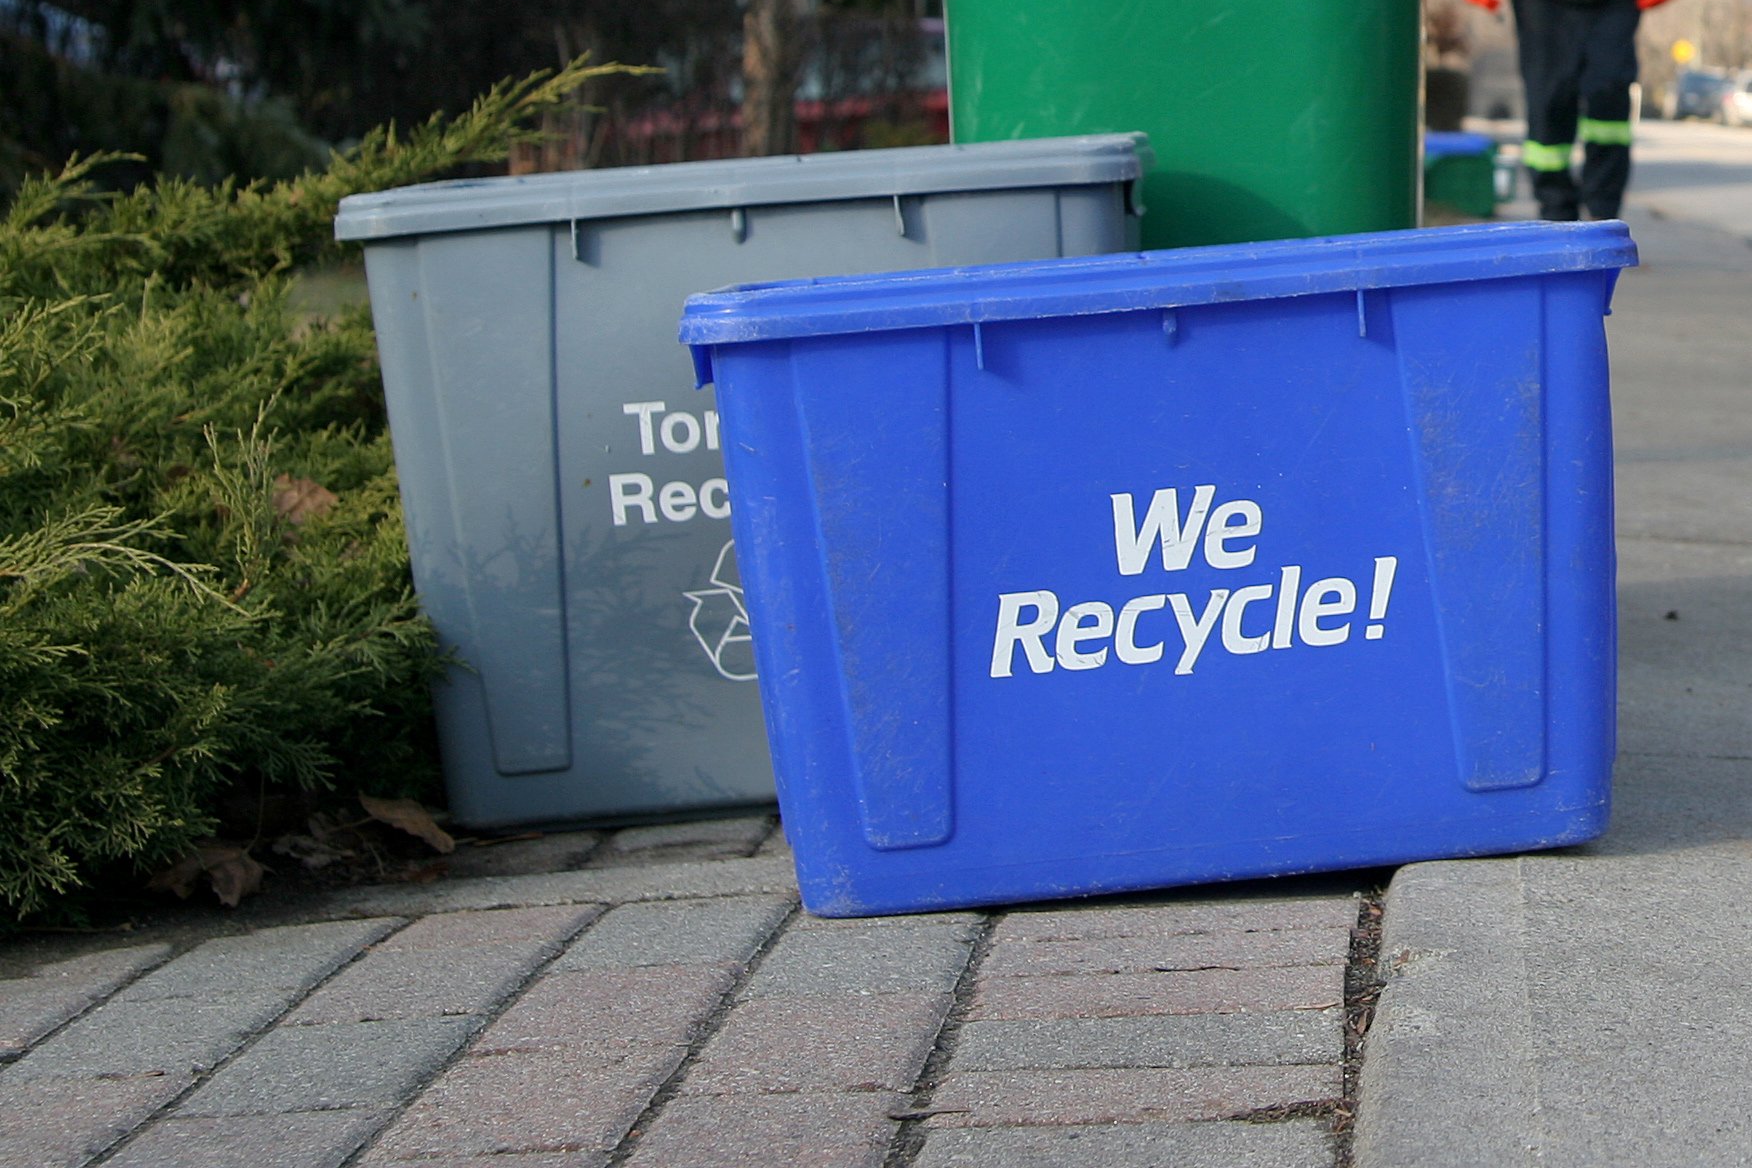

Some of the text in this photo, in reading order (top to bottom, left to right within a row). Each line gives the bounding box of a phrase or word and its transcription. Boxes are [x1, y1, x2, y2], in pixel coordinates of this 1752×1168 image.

[608, 472, 732, 526] Rec
[1110, 484, 1263, 576] We
[990, 555, 1398, 678] Recycle!
